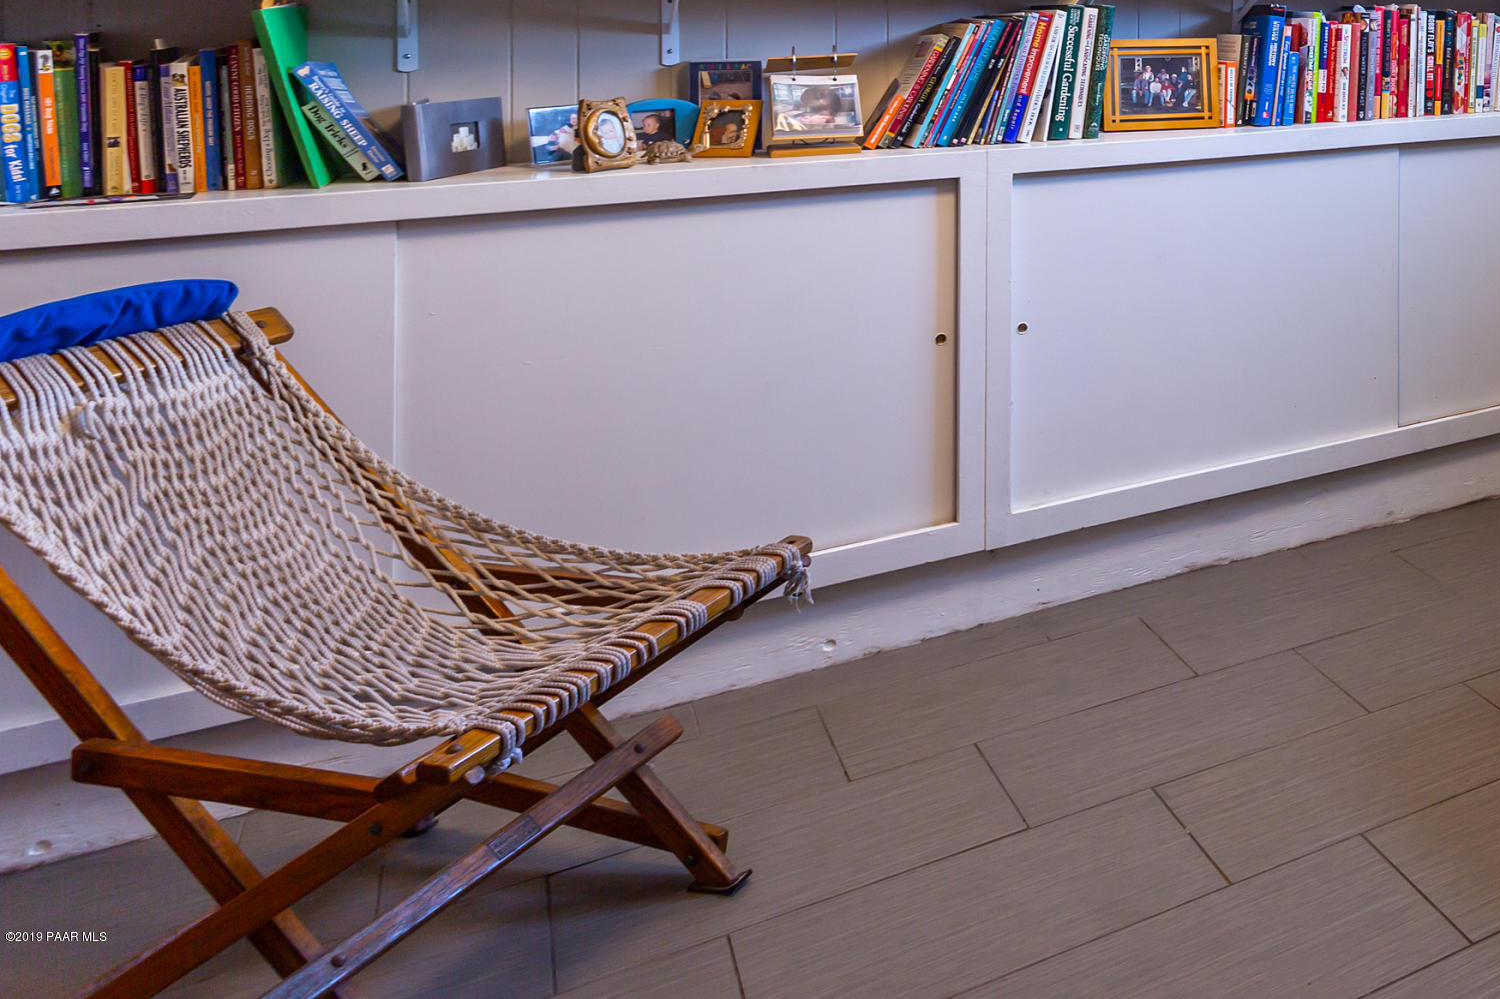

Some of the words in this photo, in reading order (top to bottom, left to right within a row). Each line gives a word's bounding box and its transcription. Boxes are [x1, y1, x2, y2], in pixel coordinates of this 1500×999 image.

[1033, 21, 1047, 48] Home
[1427, 15, 1435, 33] BOBBY
[1063, 25, 1078, 72] Successful
[1095, 33, 1103, 71] TECHNIQUES
[918, 76, 937, 103] GEORGIA
[1020, 47, 1039, 94] Improvement
[44, 107, 52, 118] Dog
[173, 87, 190, 129] AUSTRALIAN
[244, 85, 254, 118] HERDING
[307, 81, 343, 119] RAISING
[339, 118, 368, 147] SHEEP
[1056, 72, 1073, 122] Gardening
[0, 103, 21, 143] DOGS
[246, 120, 255, 140] DOGS
[307, 104, 329, 124] Dog
[325, 123, 350, 150] Tricks
[4, 145, 19, 157] for
[176, 130, 192, 169] SHEPHERDS
